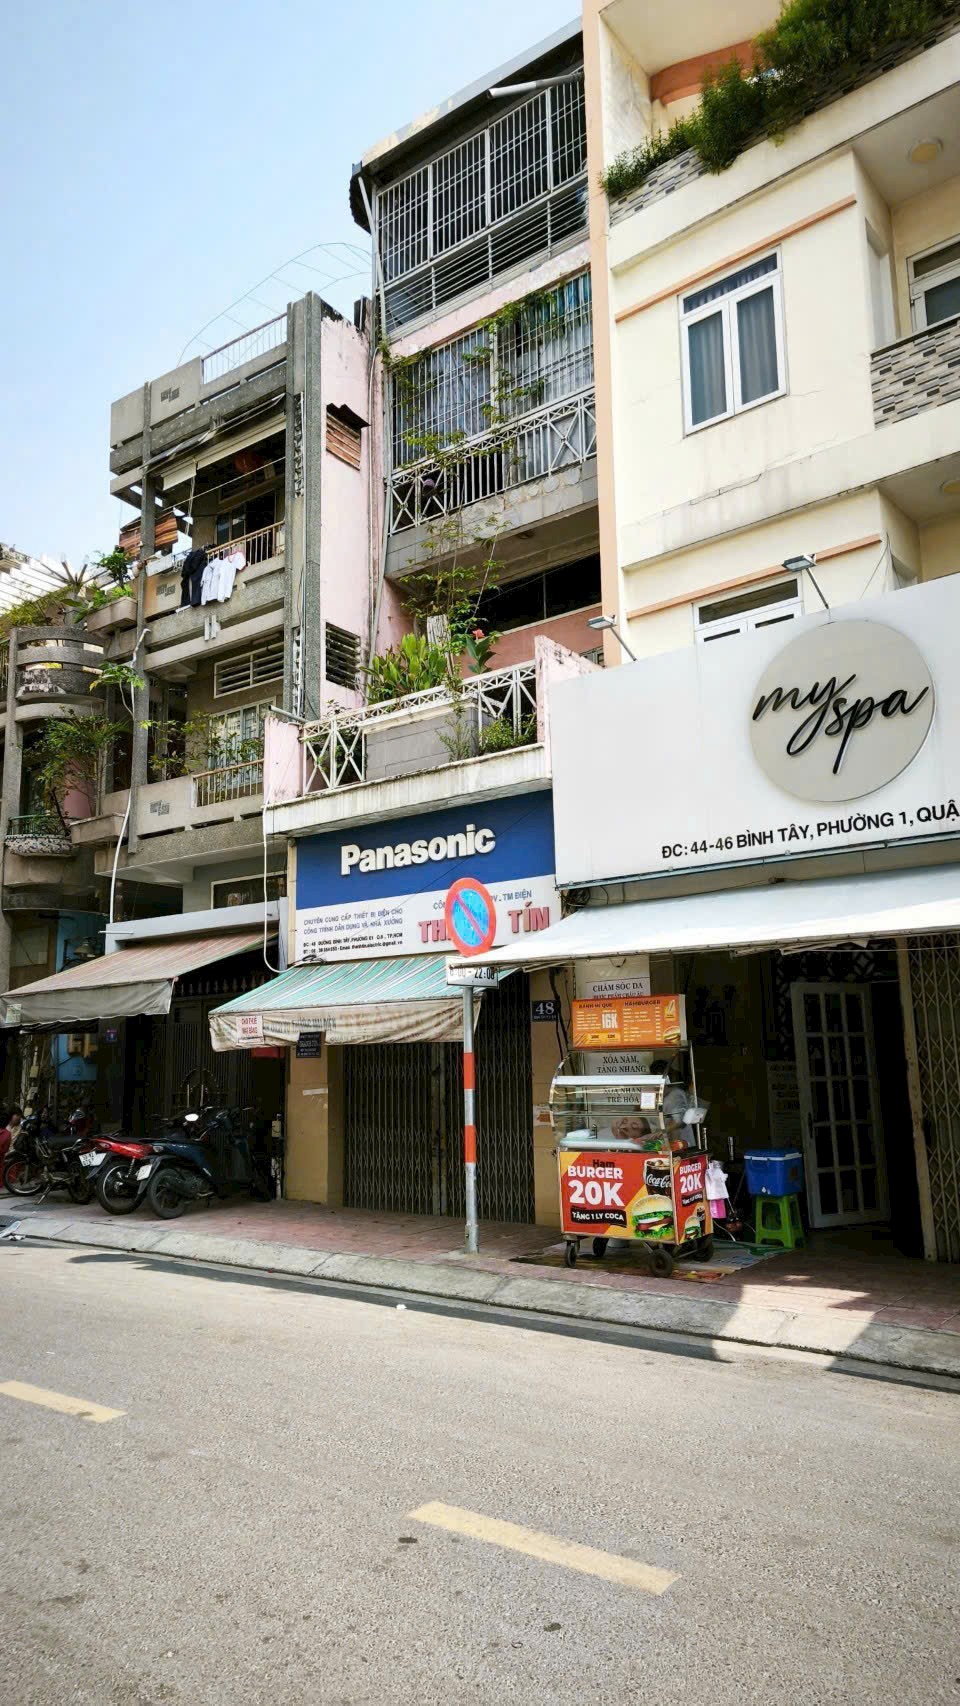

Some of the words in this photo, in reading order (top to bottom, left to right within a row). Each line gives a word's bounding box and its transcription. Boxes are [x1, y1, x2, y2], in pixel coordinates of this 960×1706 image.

[752, 674, 856, 756] my
[825, 686, 929, 774] spa
[661, 843, 688, 859] ĐC:
[690, 836, 733, 854] 44-46
[736, 829, 774, 848] BÌNH
[778, 824, 814, 841] TÂY,
[817, 812, 894, 837] PHƯỜNG
[899, 812, 913, 827] 1,
[341, 824, 496, 876] Panasonic
[514, 889, 532, 901] ĐIỆN
[341, 912, 352, 921] CẤP
[508, 901, 550, 934] TÍN
[615, 981, 631, 991] SÓC
[632, 982, 643, 990] DA
[535, 1001, 555, 1015] 48
[601, 1013, 618, 1029] 16K
[603, 1054, 619, 1064] XÓA
[592, 1159, 615, 1168] Ham
[679, 1163, 701, 1175] BURGER
[567, 1165, 624, 1180] BURGER
[679, 1172, 702, 1194] 20K
[568, 1179, 625, 1207] 20K
[572, 1211, 590, 1220] TẶNG
[605, 1212, 624, 1221] COCA
